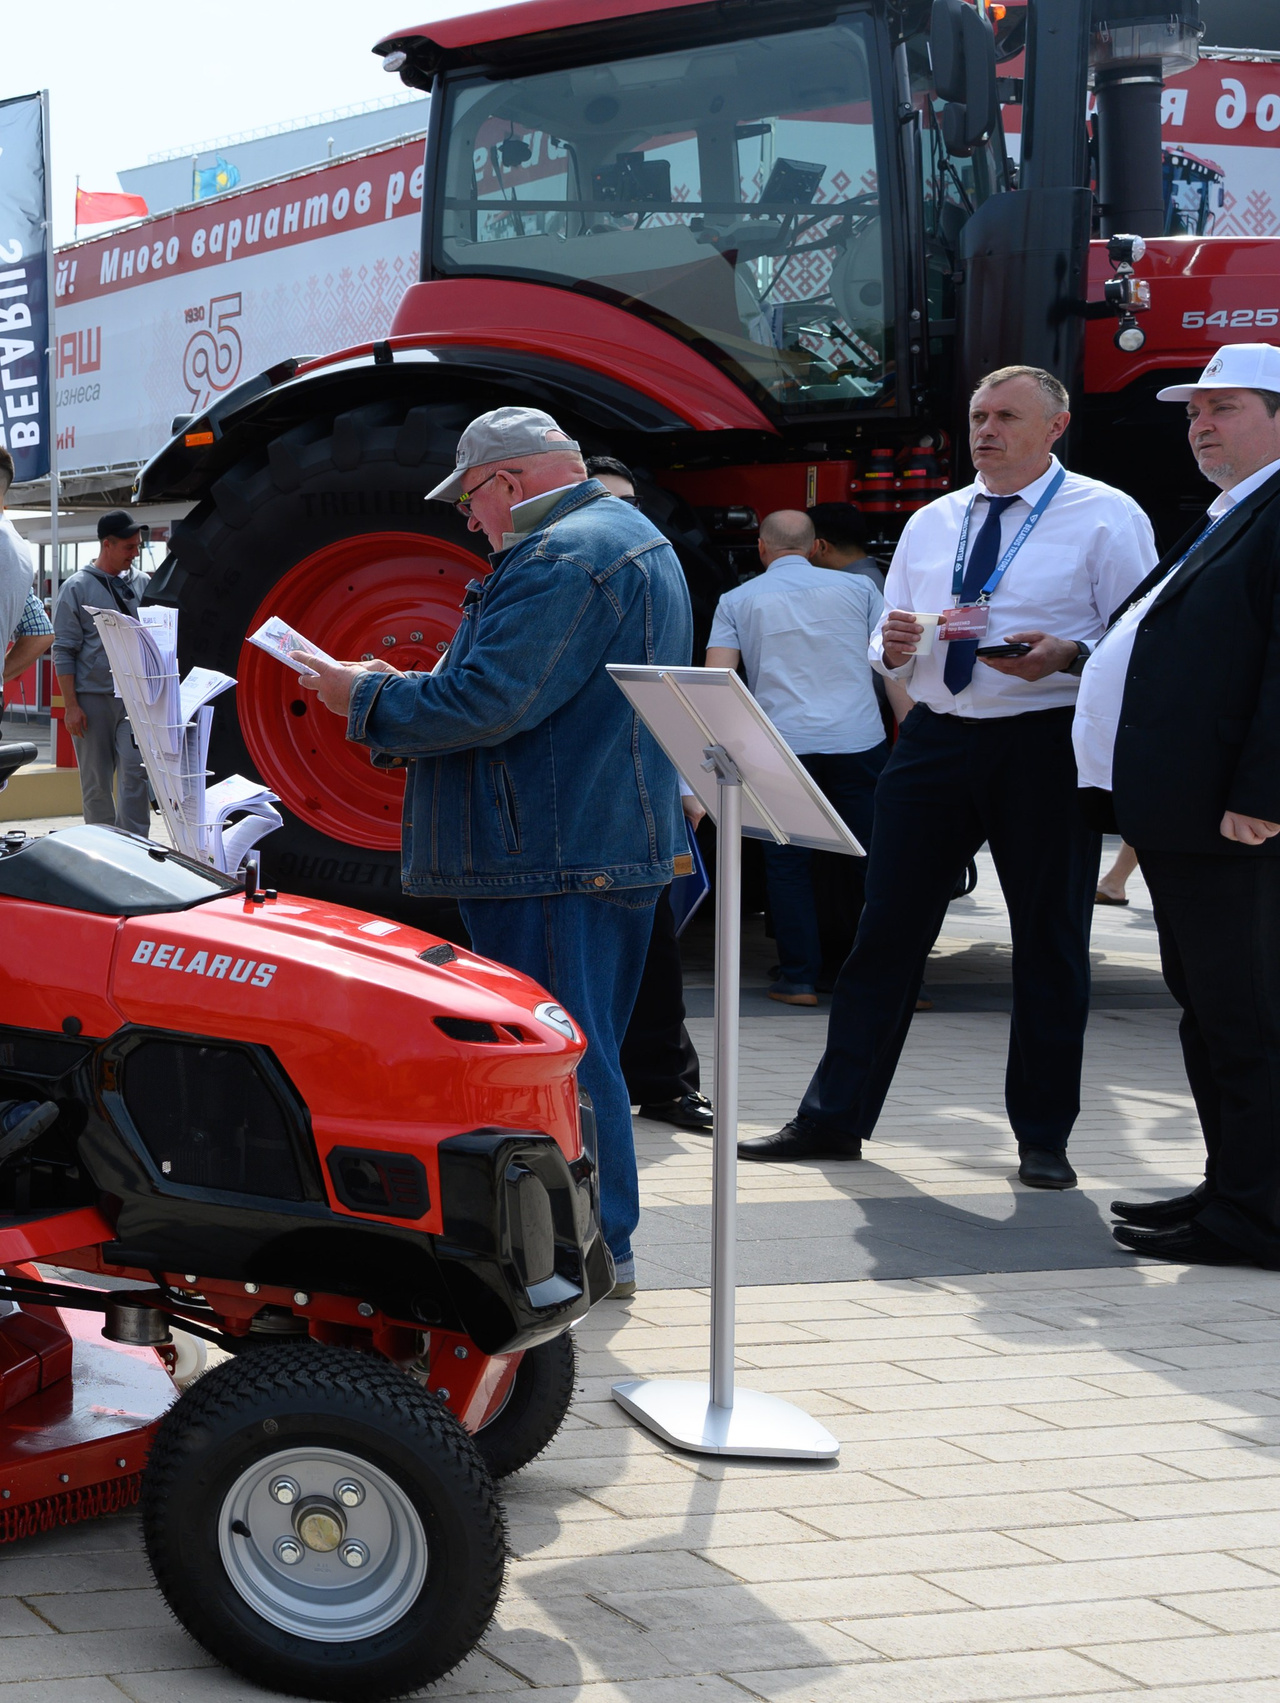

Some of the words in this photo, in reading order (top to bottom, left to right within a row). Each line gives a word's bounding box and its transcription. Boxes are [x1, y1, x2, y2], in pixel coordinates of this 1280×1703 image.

[99, 248, 180, 286] Много
[191, 181, 371, 261] вариантов
[184, 306, 205, 324] 1930
[1181, 308, 1280, 329] 5425
[56, 326, 101, 379] АШ
[131, 940, 278, 988] BELARUS
